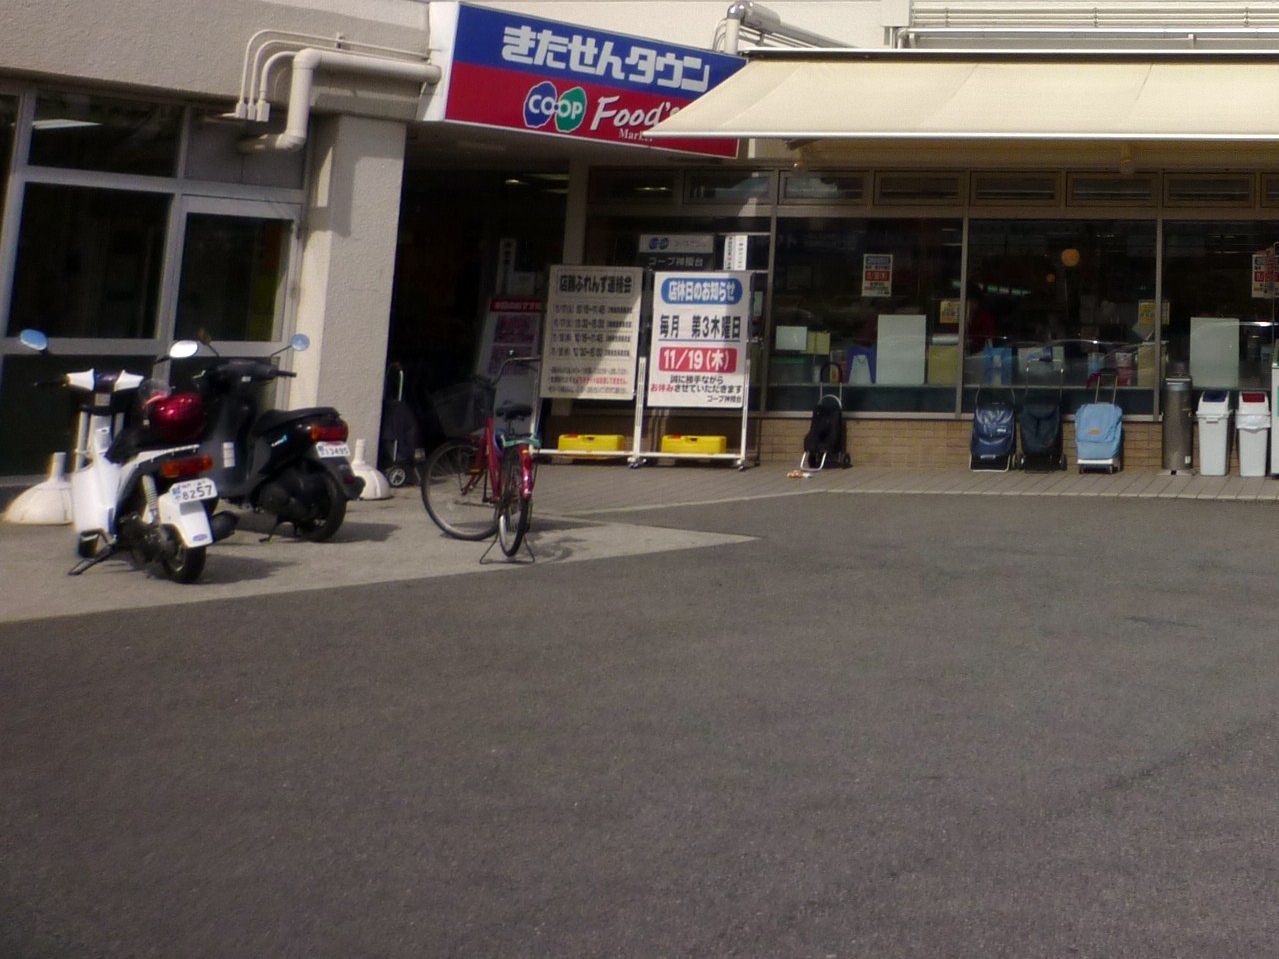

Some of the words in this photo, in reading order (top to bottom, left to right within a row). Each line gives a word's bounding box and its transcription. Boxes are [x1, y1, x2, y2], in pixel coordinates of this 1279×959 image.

[501, 25, 710, 93] きたせんタウン
[668, 280, 736, 301] 店休日のお知らせ
[659, 314, 680, 338] 毎月
[691, 314, 742, 339] 第3木曜日
[650, 384, 743, 394] お休みさせていただきます
[670, 375, 724, 385] 誠に勝手ながら
[182, 484, 212, 500] 8257
